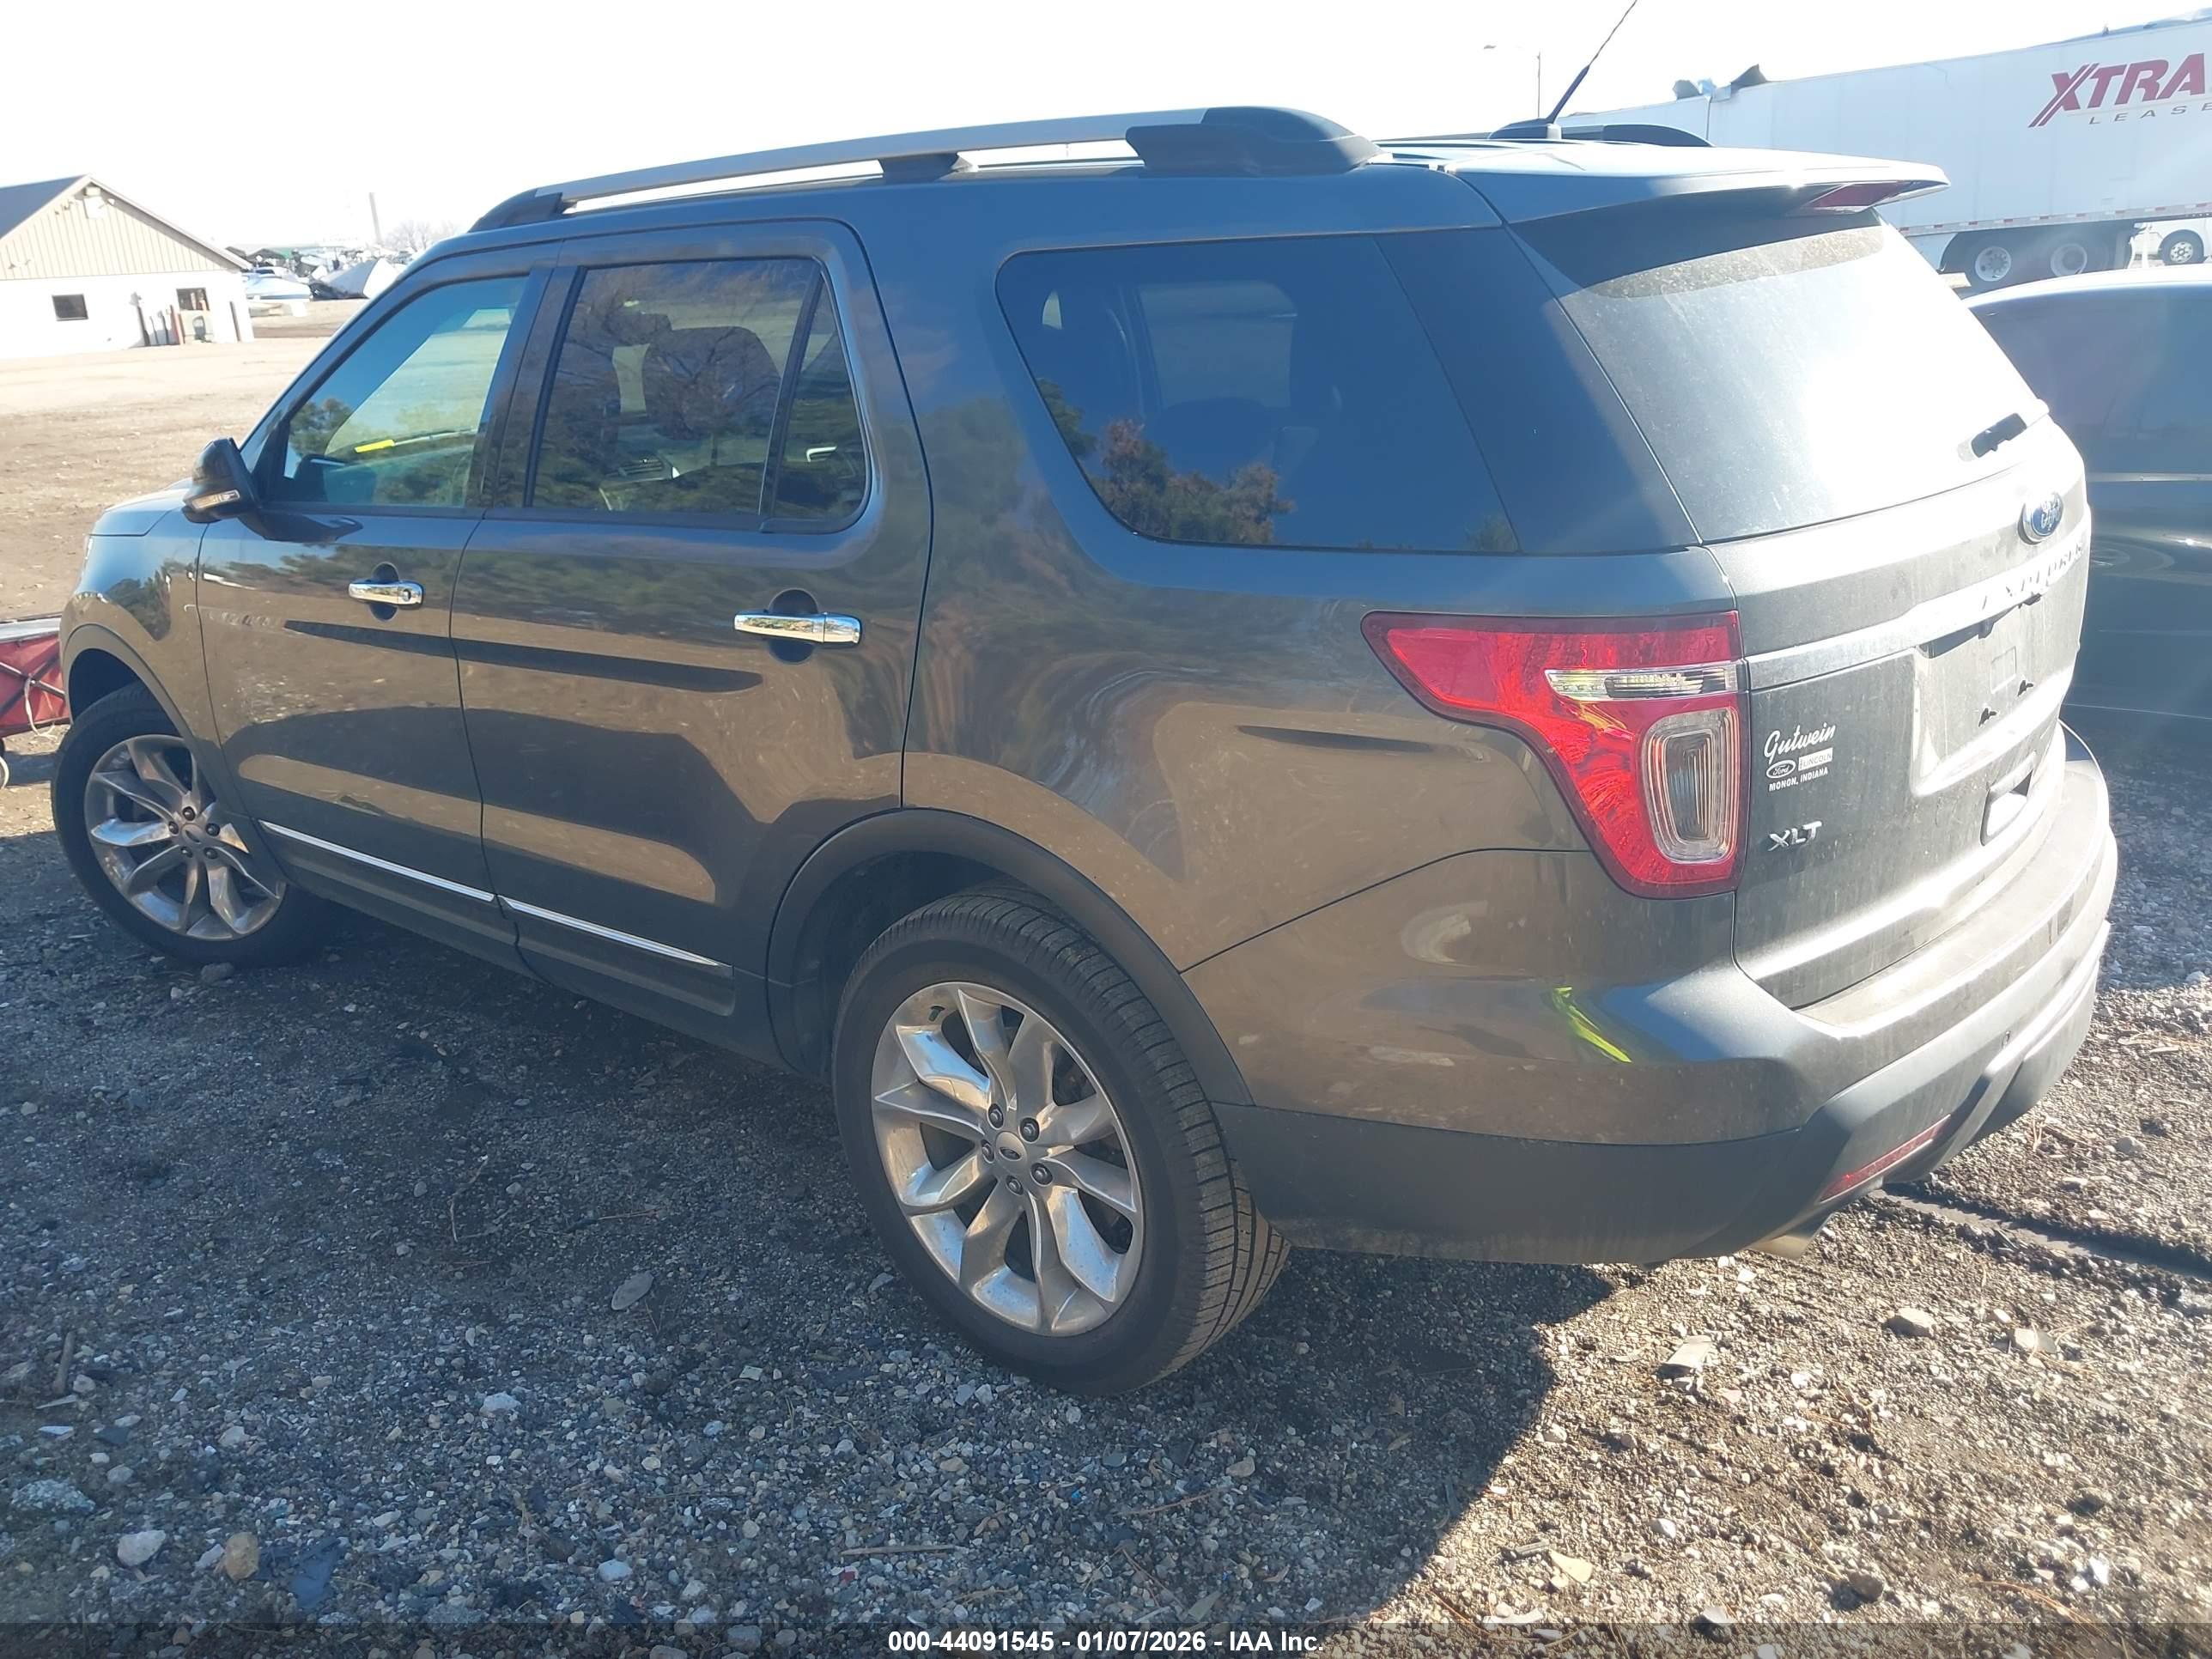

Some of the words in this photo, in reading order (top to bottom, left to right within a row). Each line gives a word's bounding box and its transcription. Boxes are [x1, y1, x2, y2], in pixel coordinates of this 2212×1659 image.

[2028, 52, 2206, 128] XTRA
[2088, 102, 2212, 125] LEASE
[1764, 722, 1836, 764] Gutwein
[1800, 767, 1828, 783] INDIANA
[1802, 754, 1832, 769] LINCOLN
[1768, 820, 1822, 852] XLT
